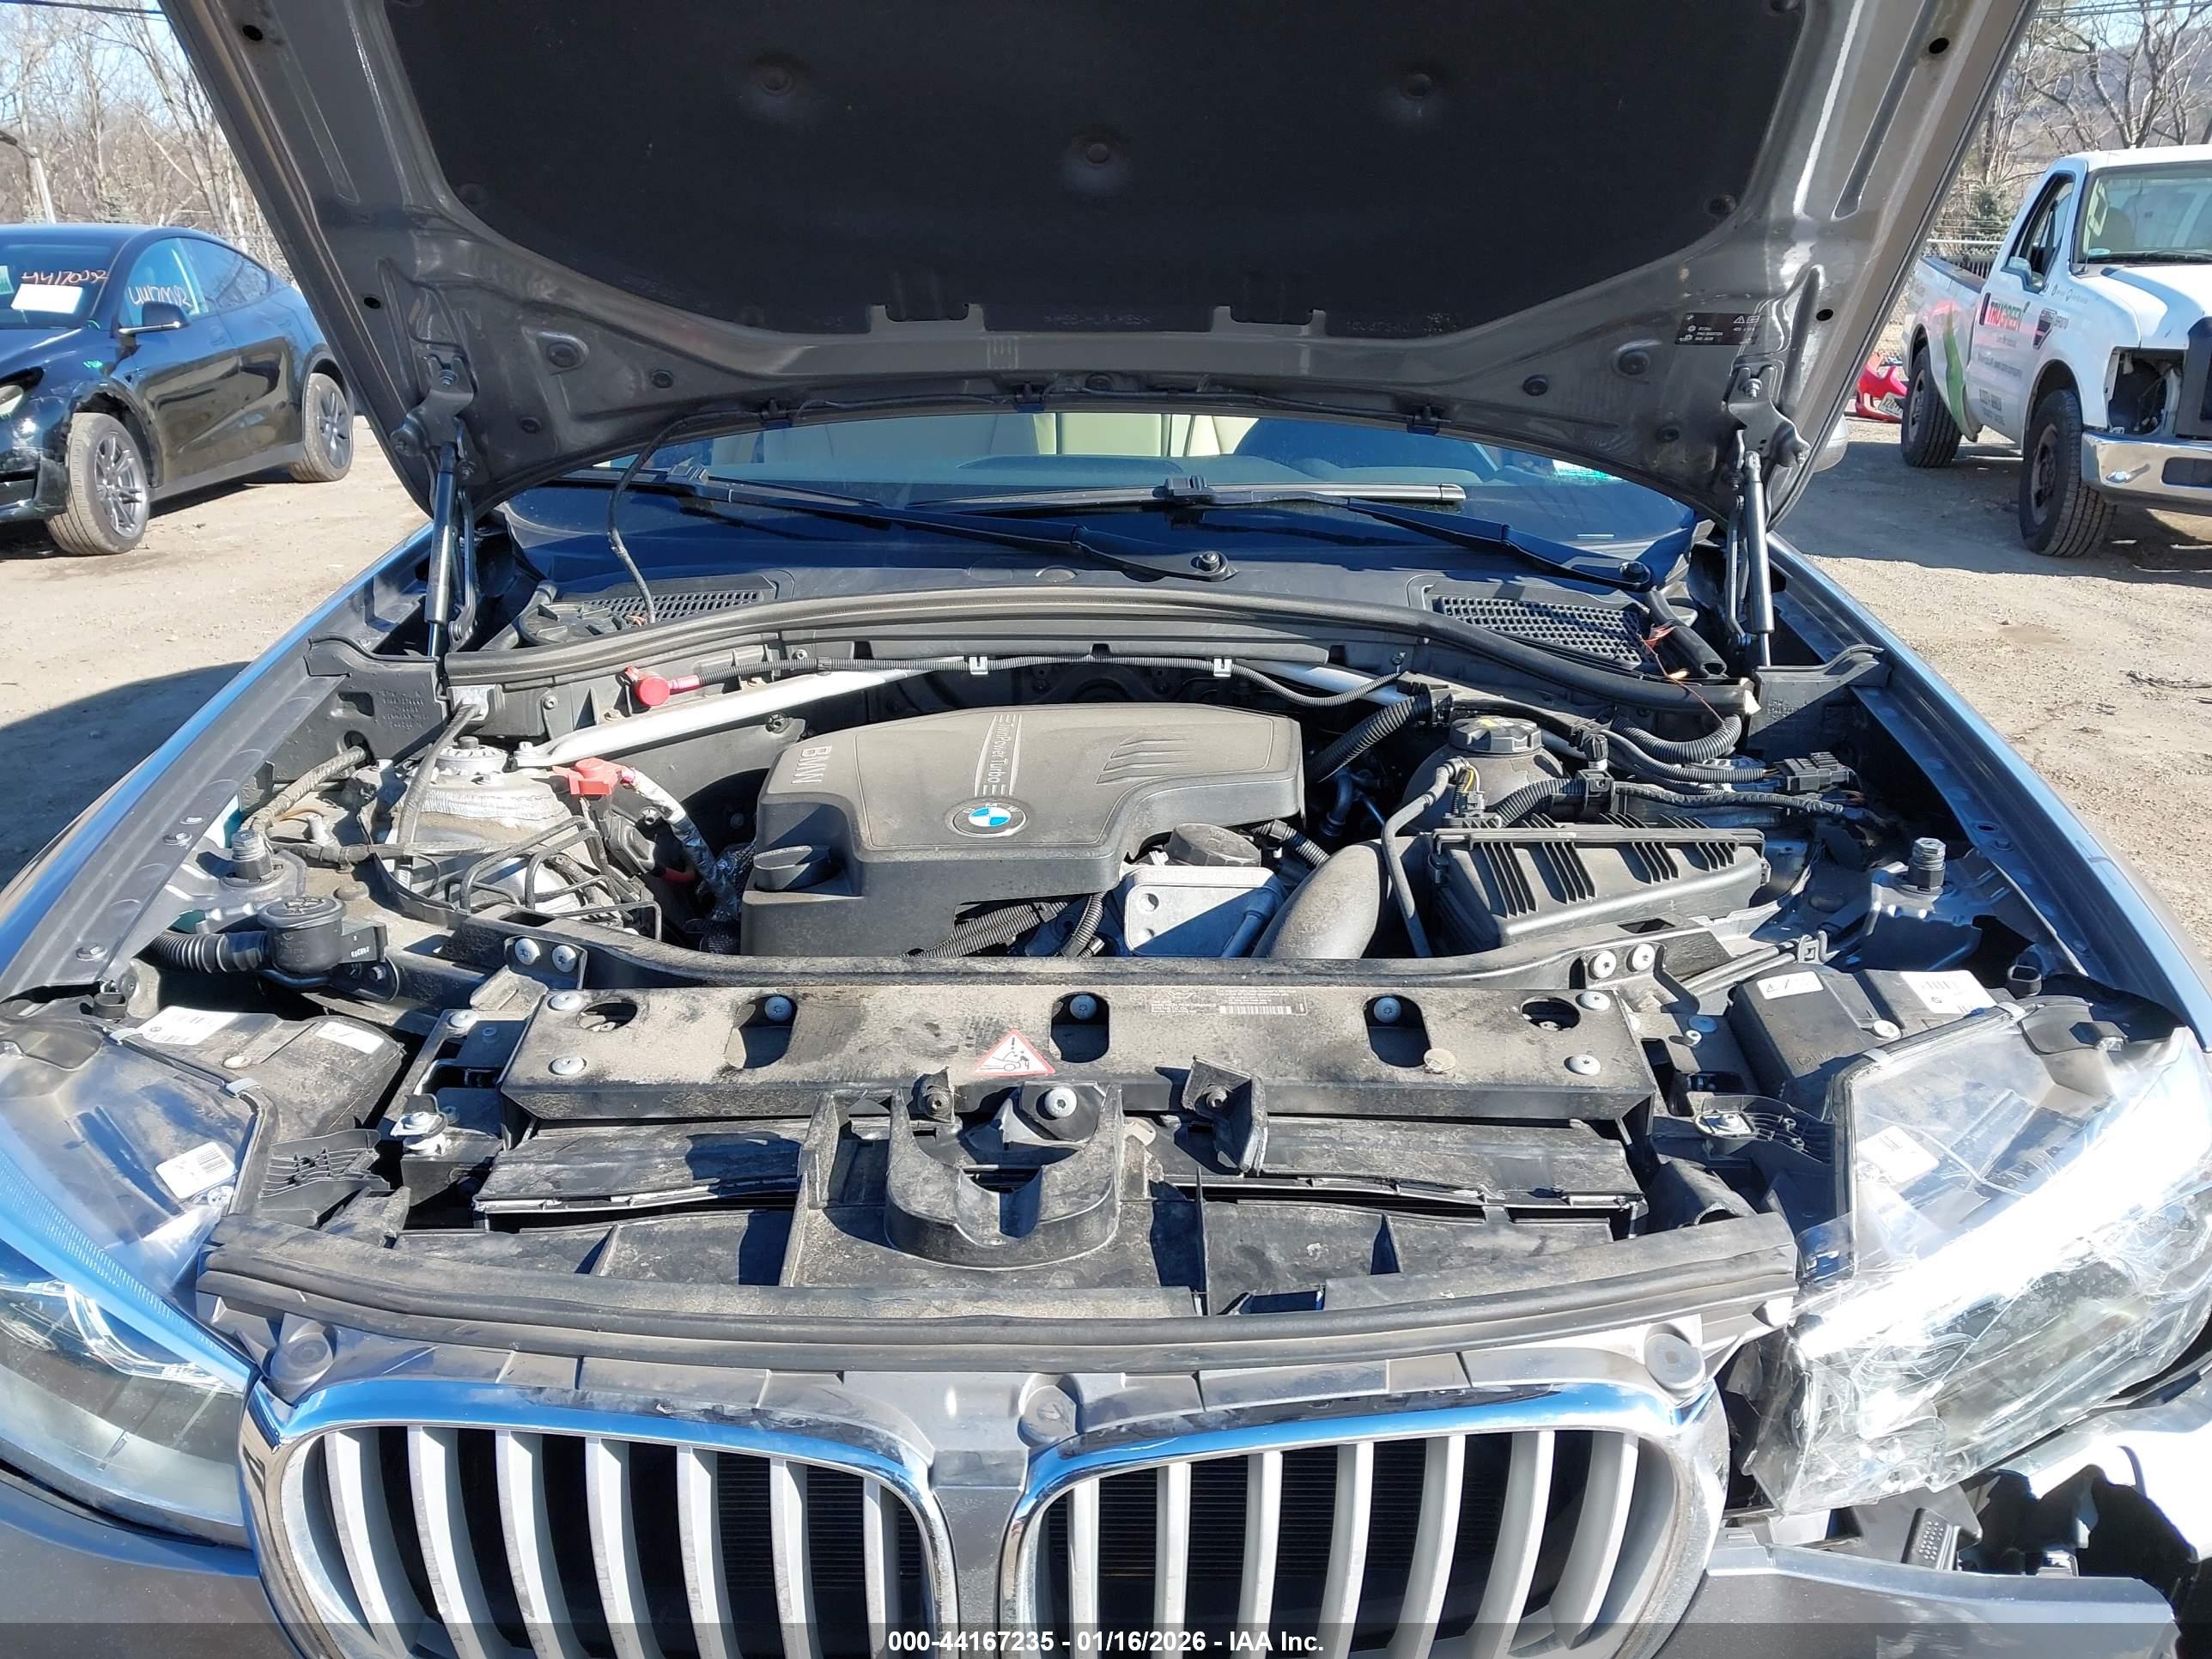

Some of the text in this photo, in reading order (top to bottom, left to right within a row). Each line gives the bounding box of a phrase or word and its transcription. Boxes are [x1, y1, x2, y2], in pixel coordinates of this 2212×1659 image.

[791, 745, 832, 785] BMW
[988, 722, 1015, 783] TwinPower Turbo
